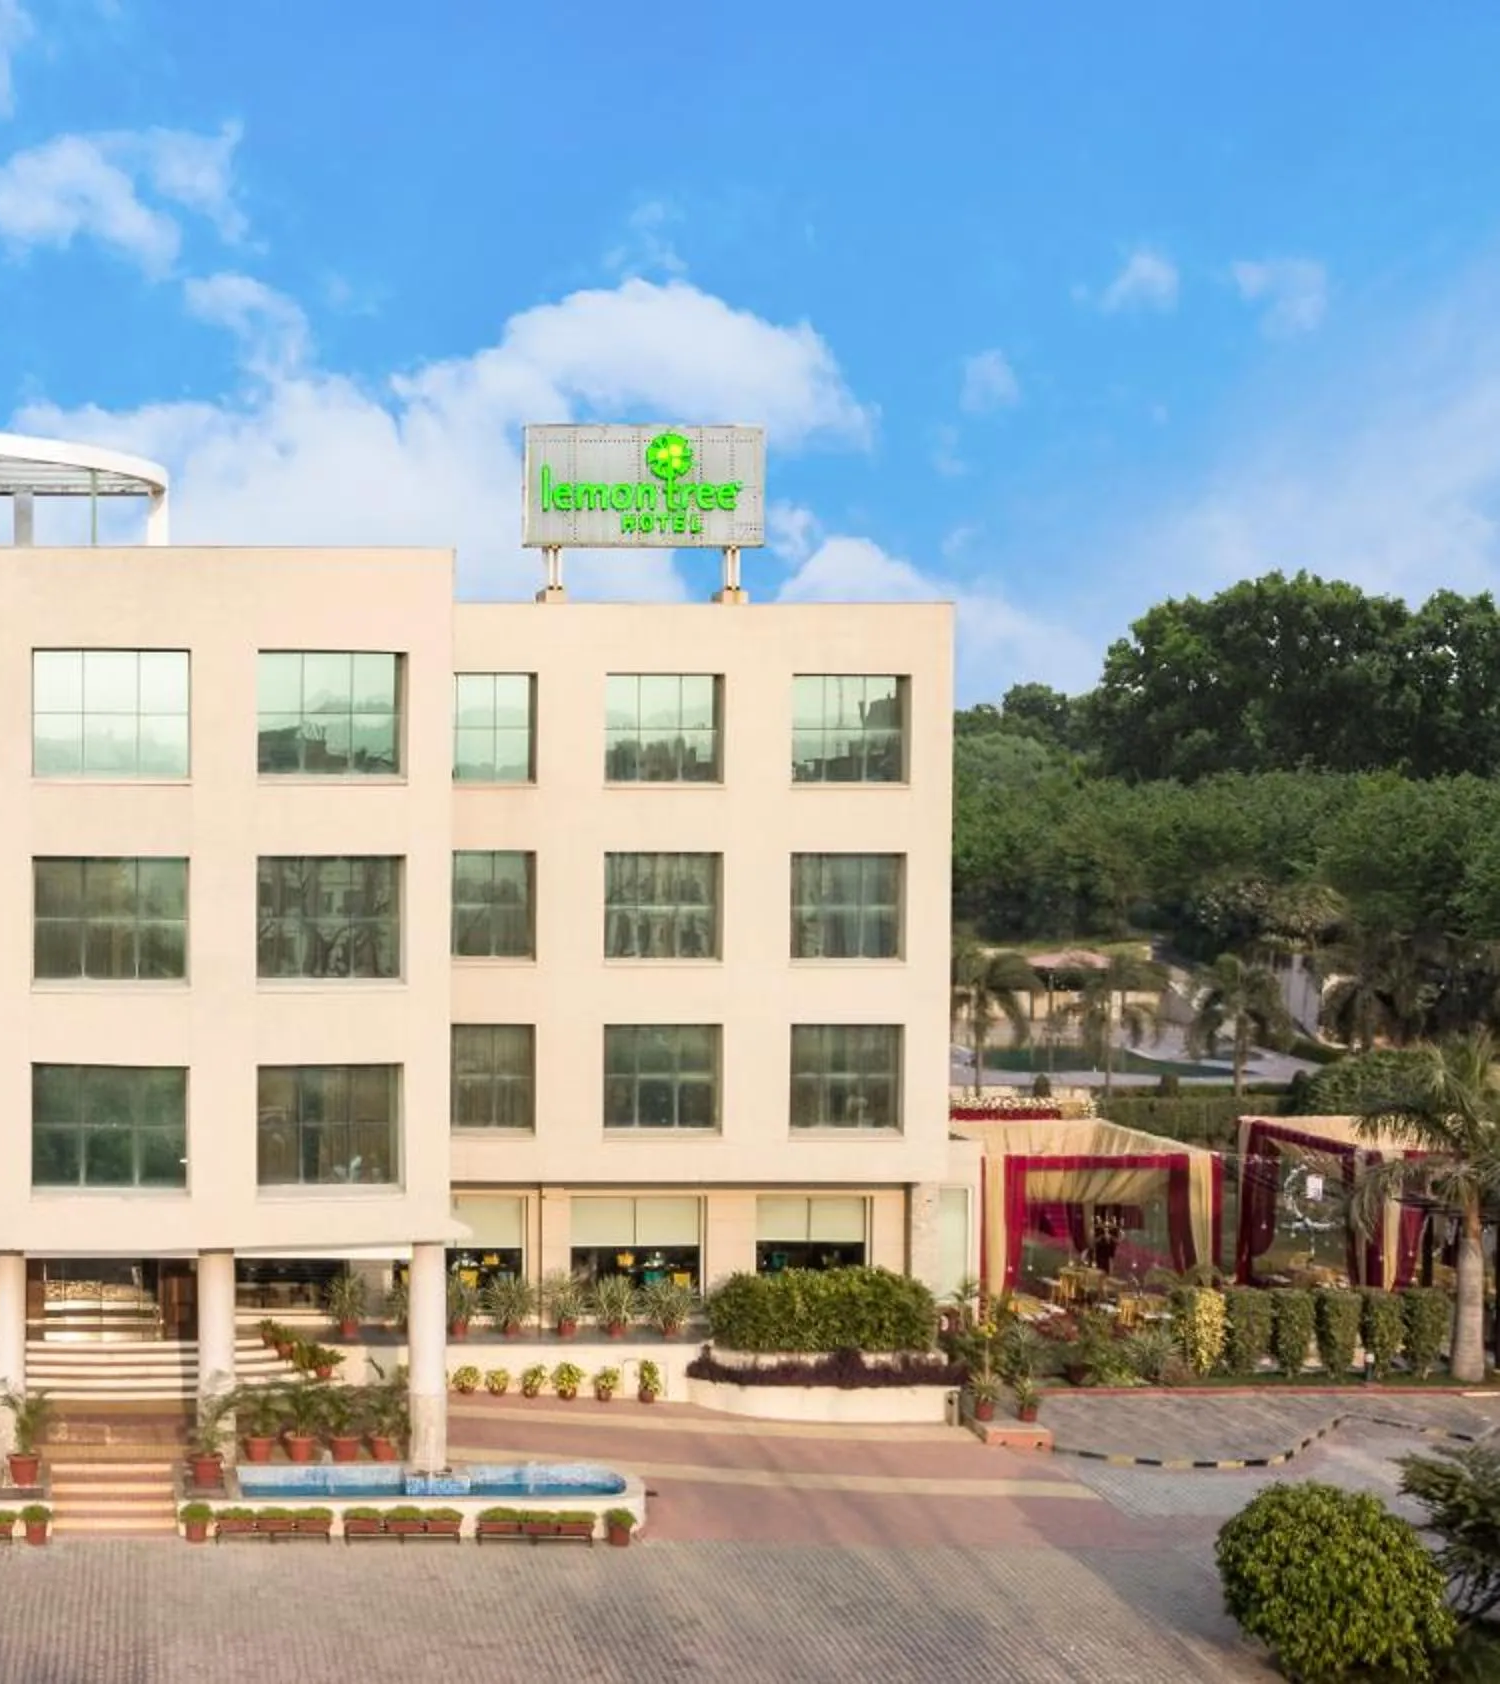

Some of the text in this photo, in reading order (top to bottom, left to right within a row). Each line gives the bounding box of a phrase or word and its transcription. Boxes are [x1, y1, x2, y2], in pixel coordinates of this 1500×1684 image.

[540, 464, 739, 512] lemon tree
[620, 512, 703, 534] HOTEL
